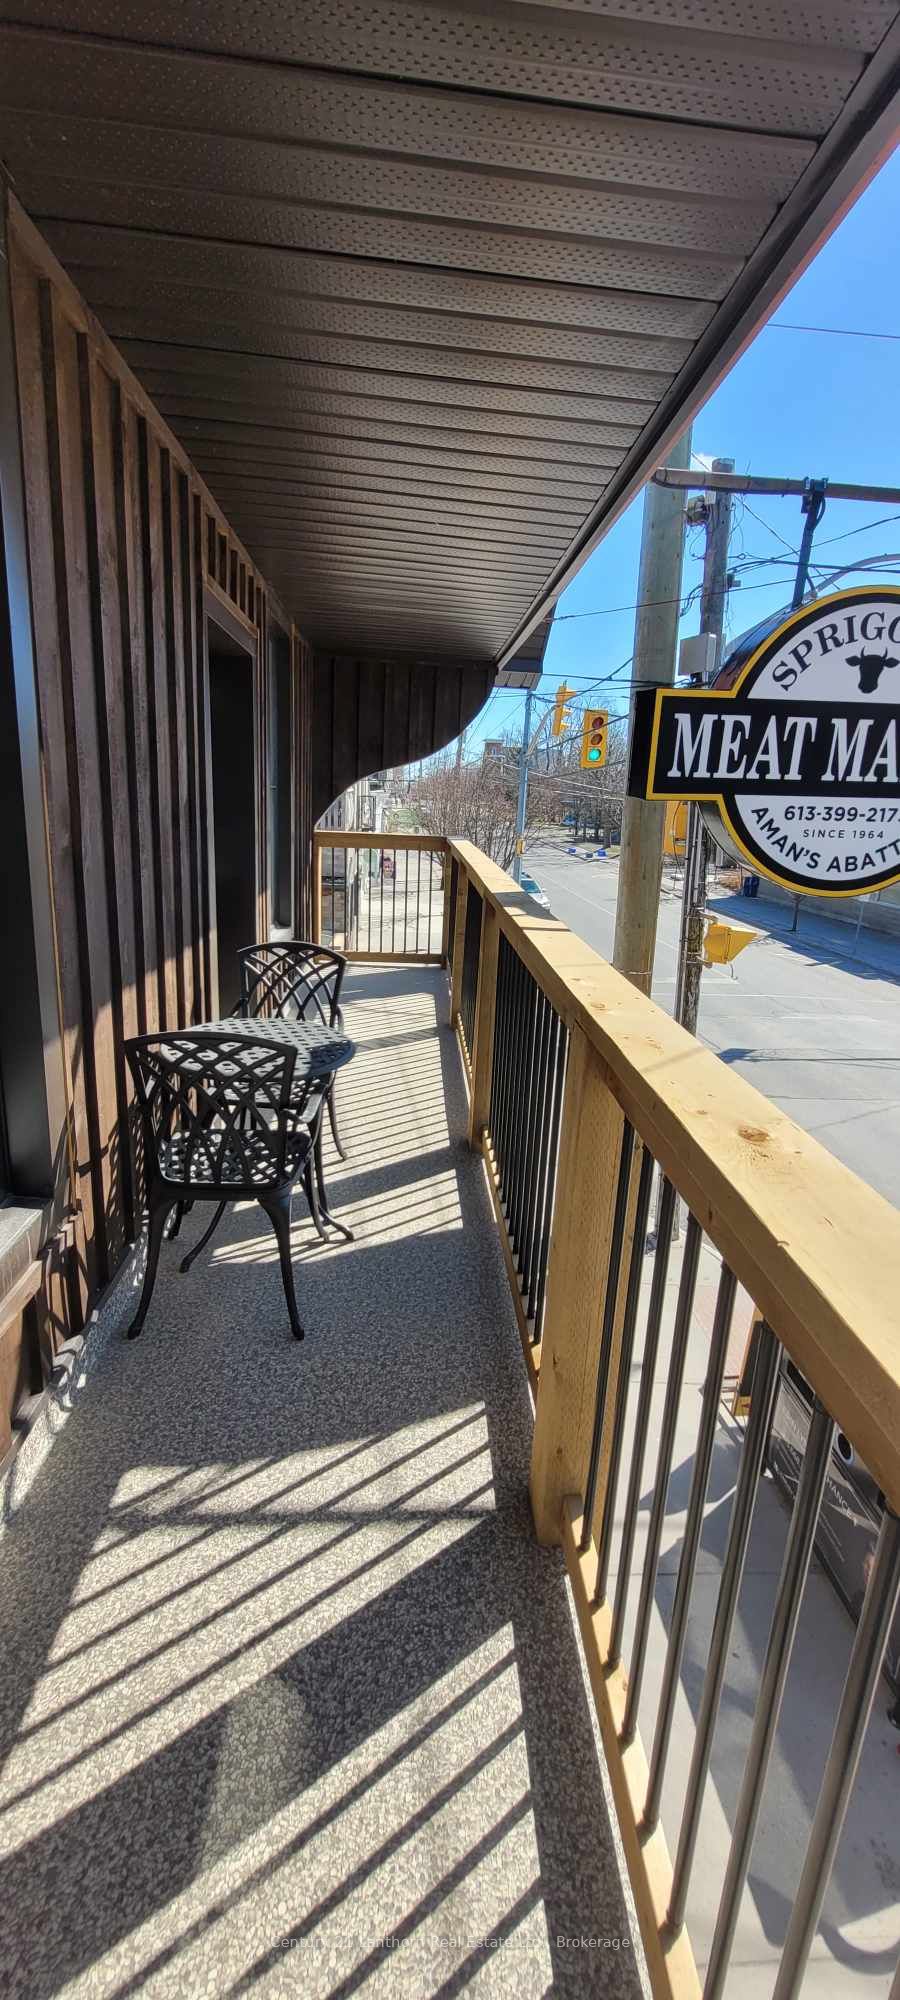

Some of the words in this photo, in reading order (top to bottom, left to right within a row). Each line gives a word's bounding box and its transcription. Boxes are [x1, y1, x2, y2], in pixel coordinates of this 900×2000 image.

[667, 712, 818, 781] MEAT
[784, 805, 900, 823] 613-399-217
[803, 829, 845, 839] SINCE
[853, 830, 884, 839] 1964
[751, 807, 821, 869] AMAN'S
